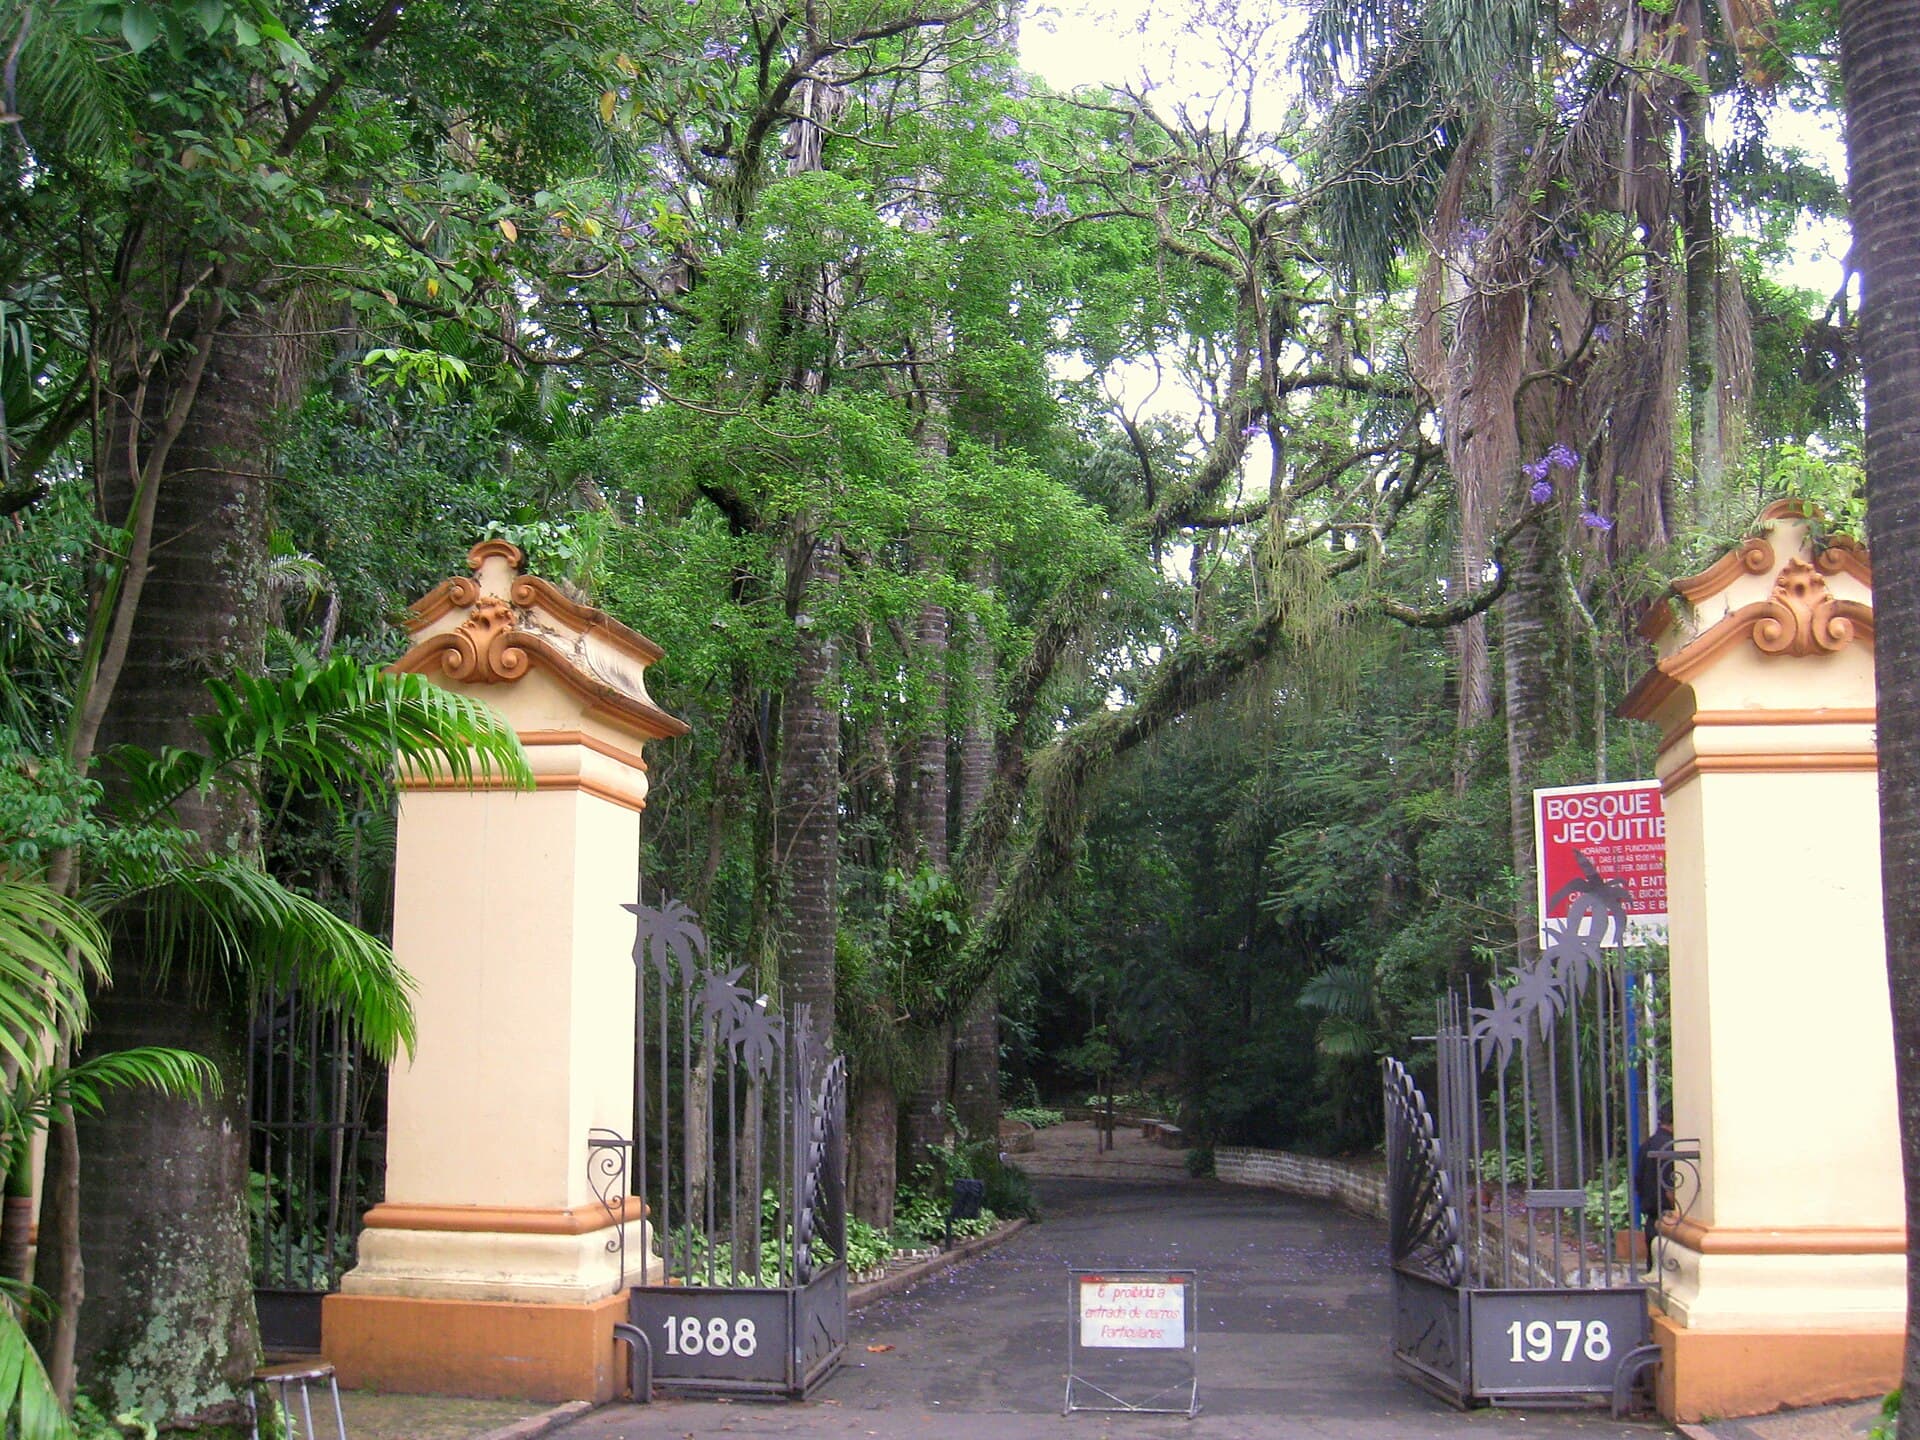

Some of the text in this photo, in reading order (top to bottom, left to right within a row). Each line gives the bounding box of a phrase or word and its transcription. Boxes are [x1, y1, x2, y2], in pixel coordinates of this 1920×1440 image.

[1546, 793, 1651, 820] BOSQUE
[663, 1316, 757, 1357] 1888
[1506, 1320, 1611, 1362] 1978
